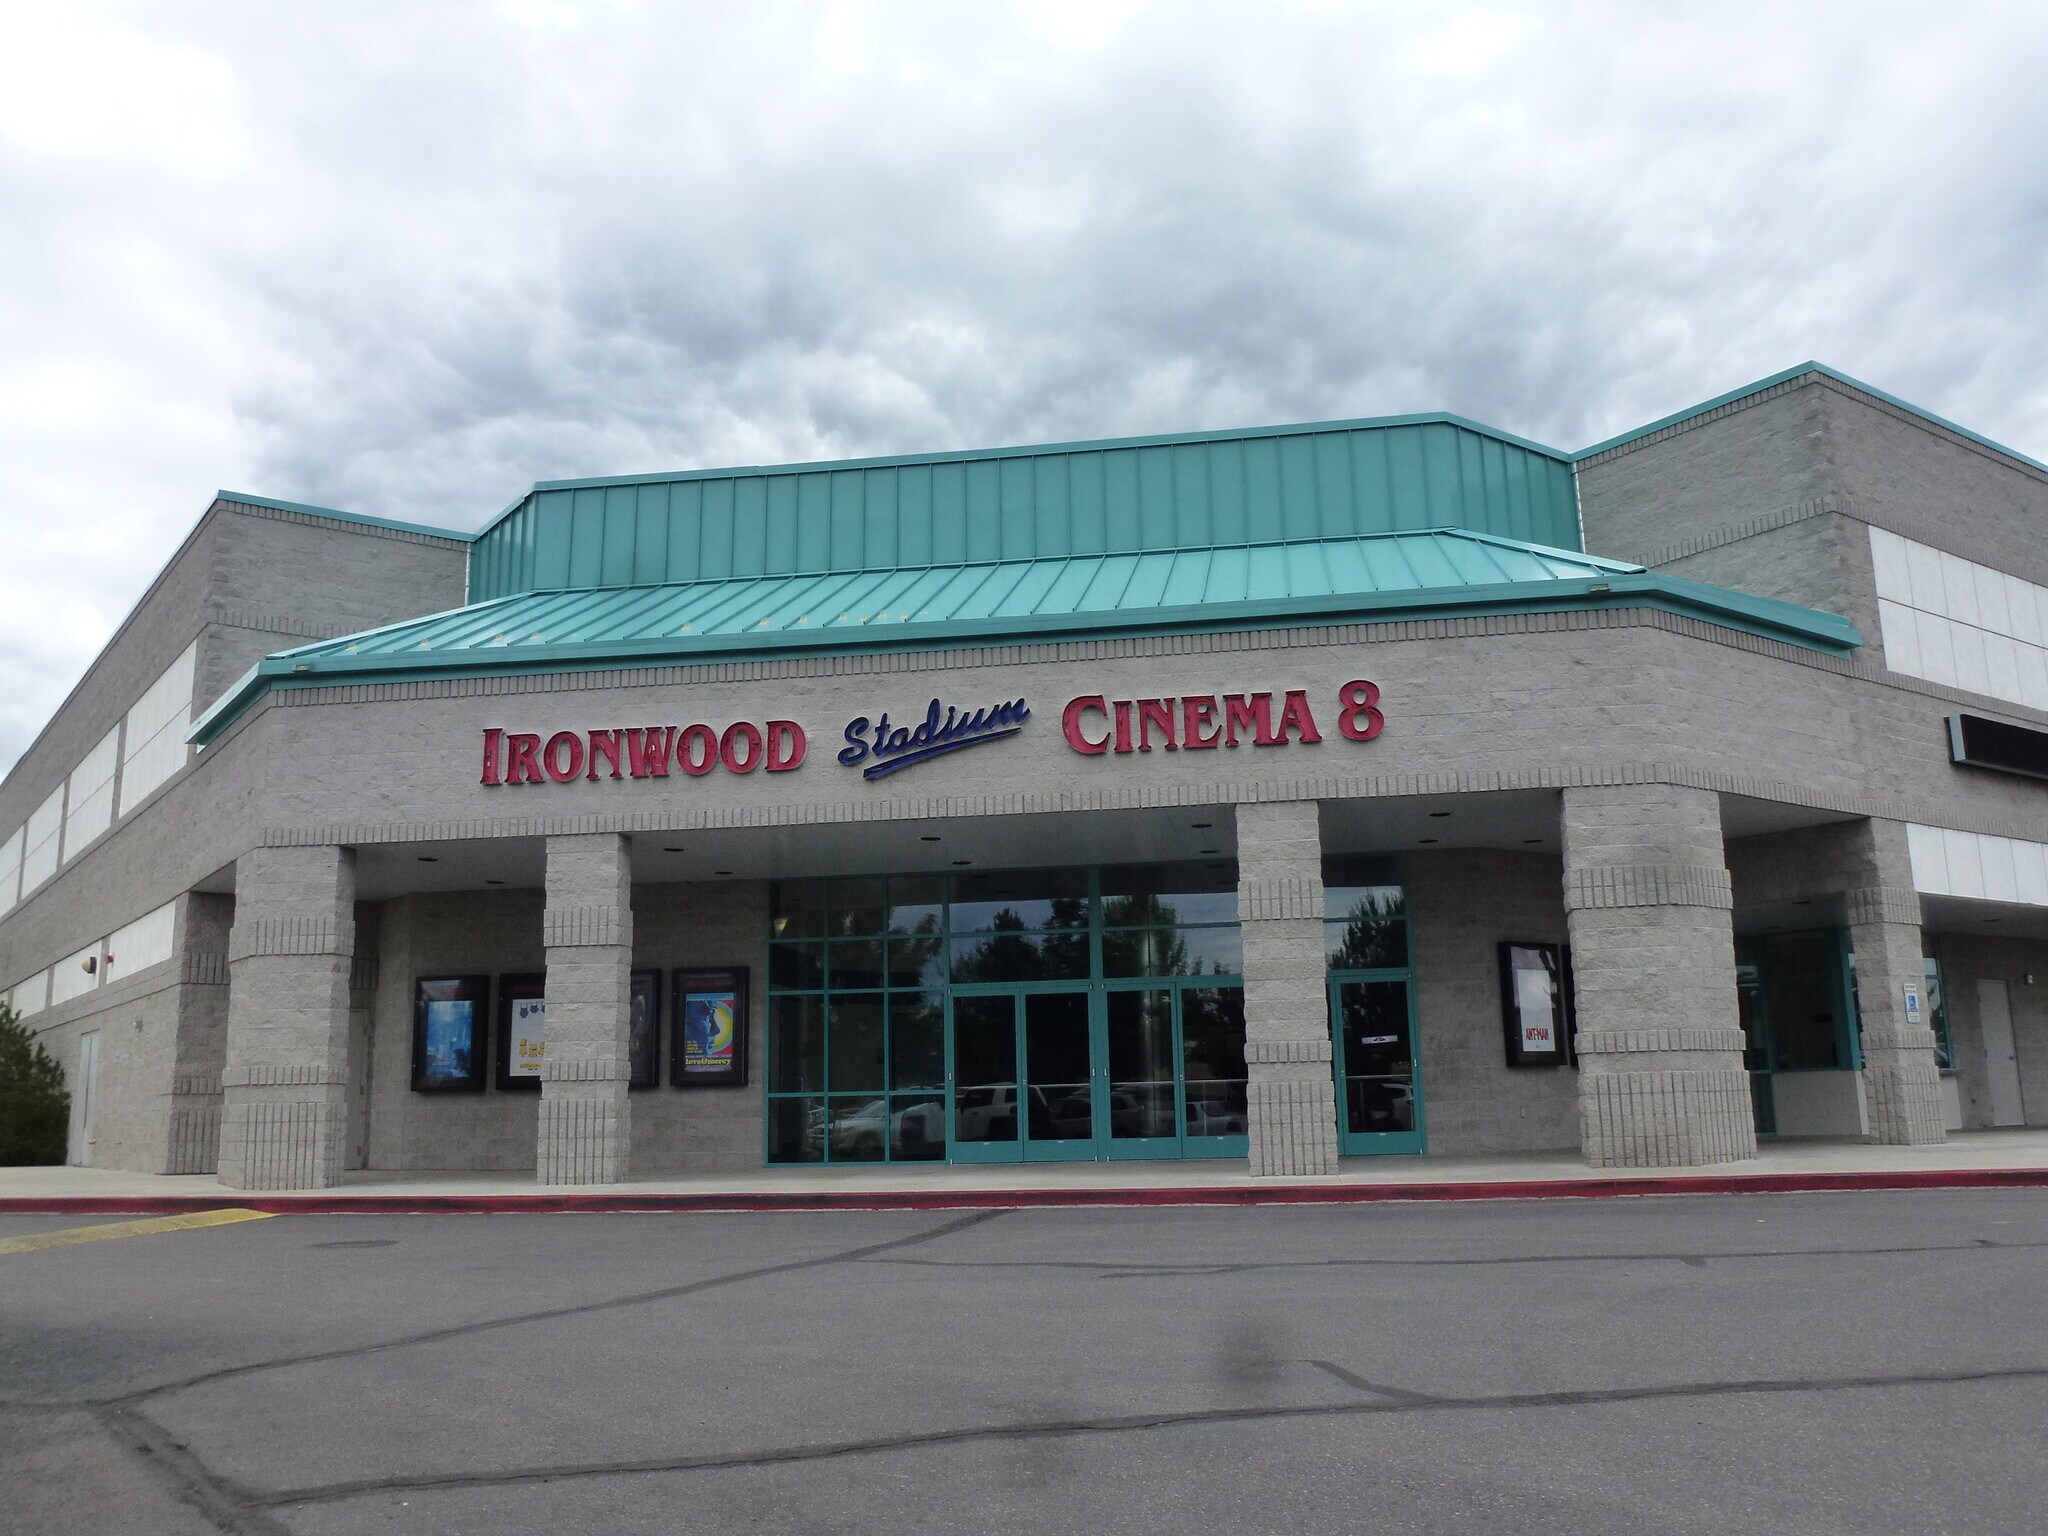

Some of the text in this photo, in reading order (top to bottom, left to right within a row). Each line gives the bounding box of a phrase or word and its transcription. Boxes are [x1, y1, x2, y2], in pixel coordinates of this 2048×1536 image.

[481, 680, 1385, 786] IRONWOOD Stadium CINEMA 8
